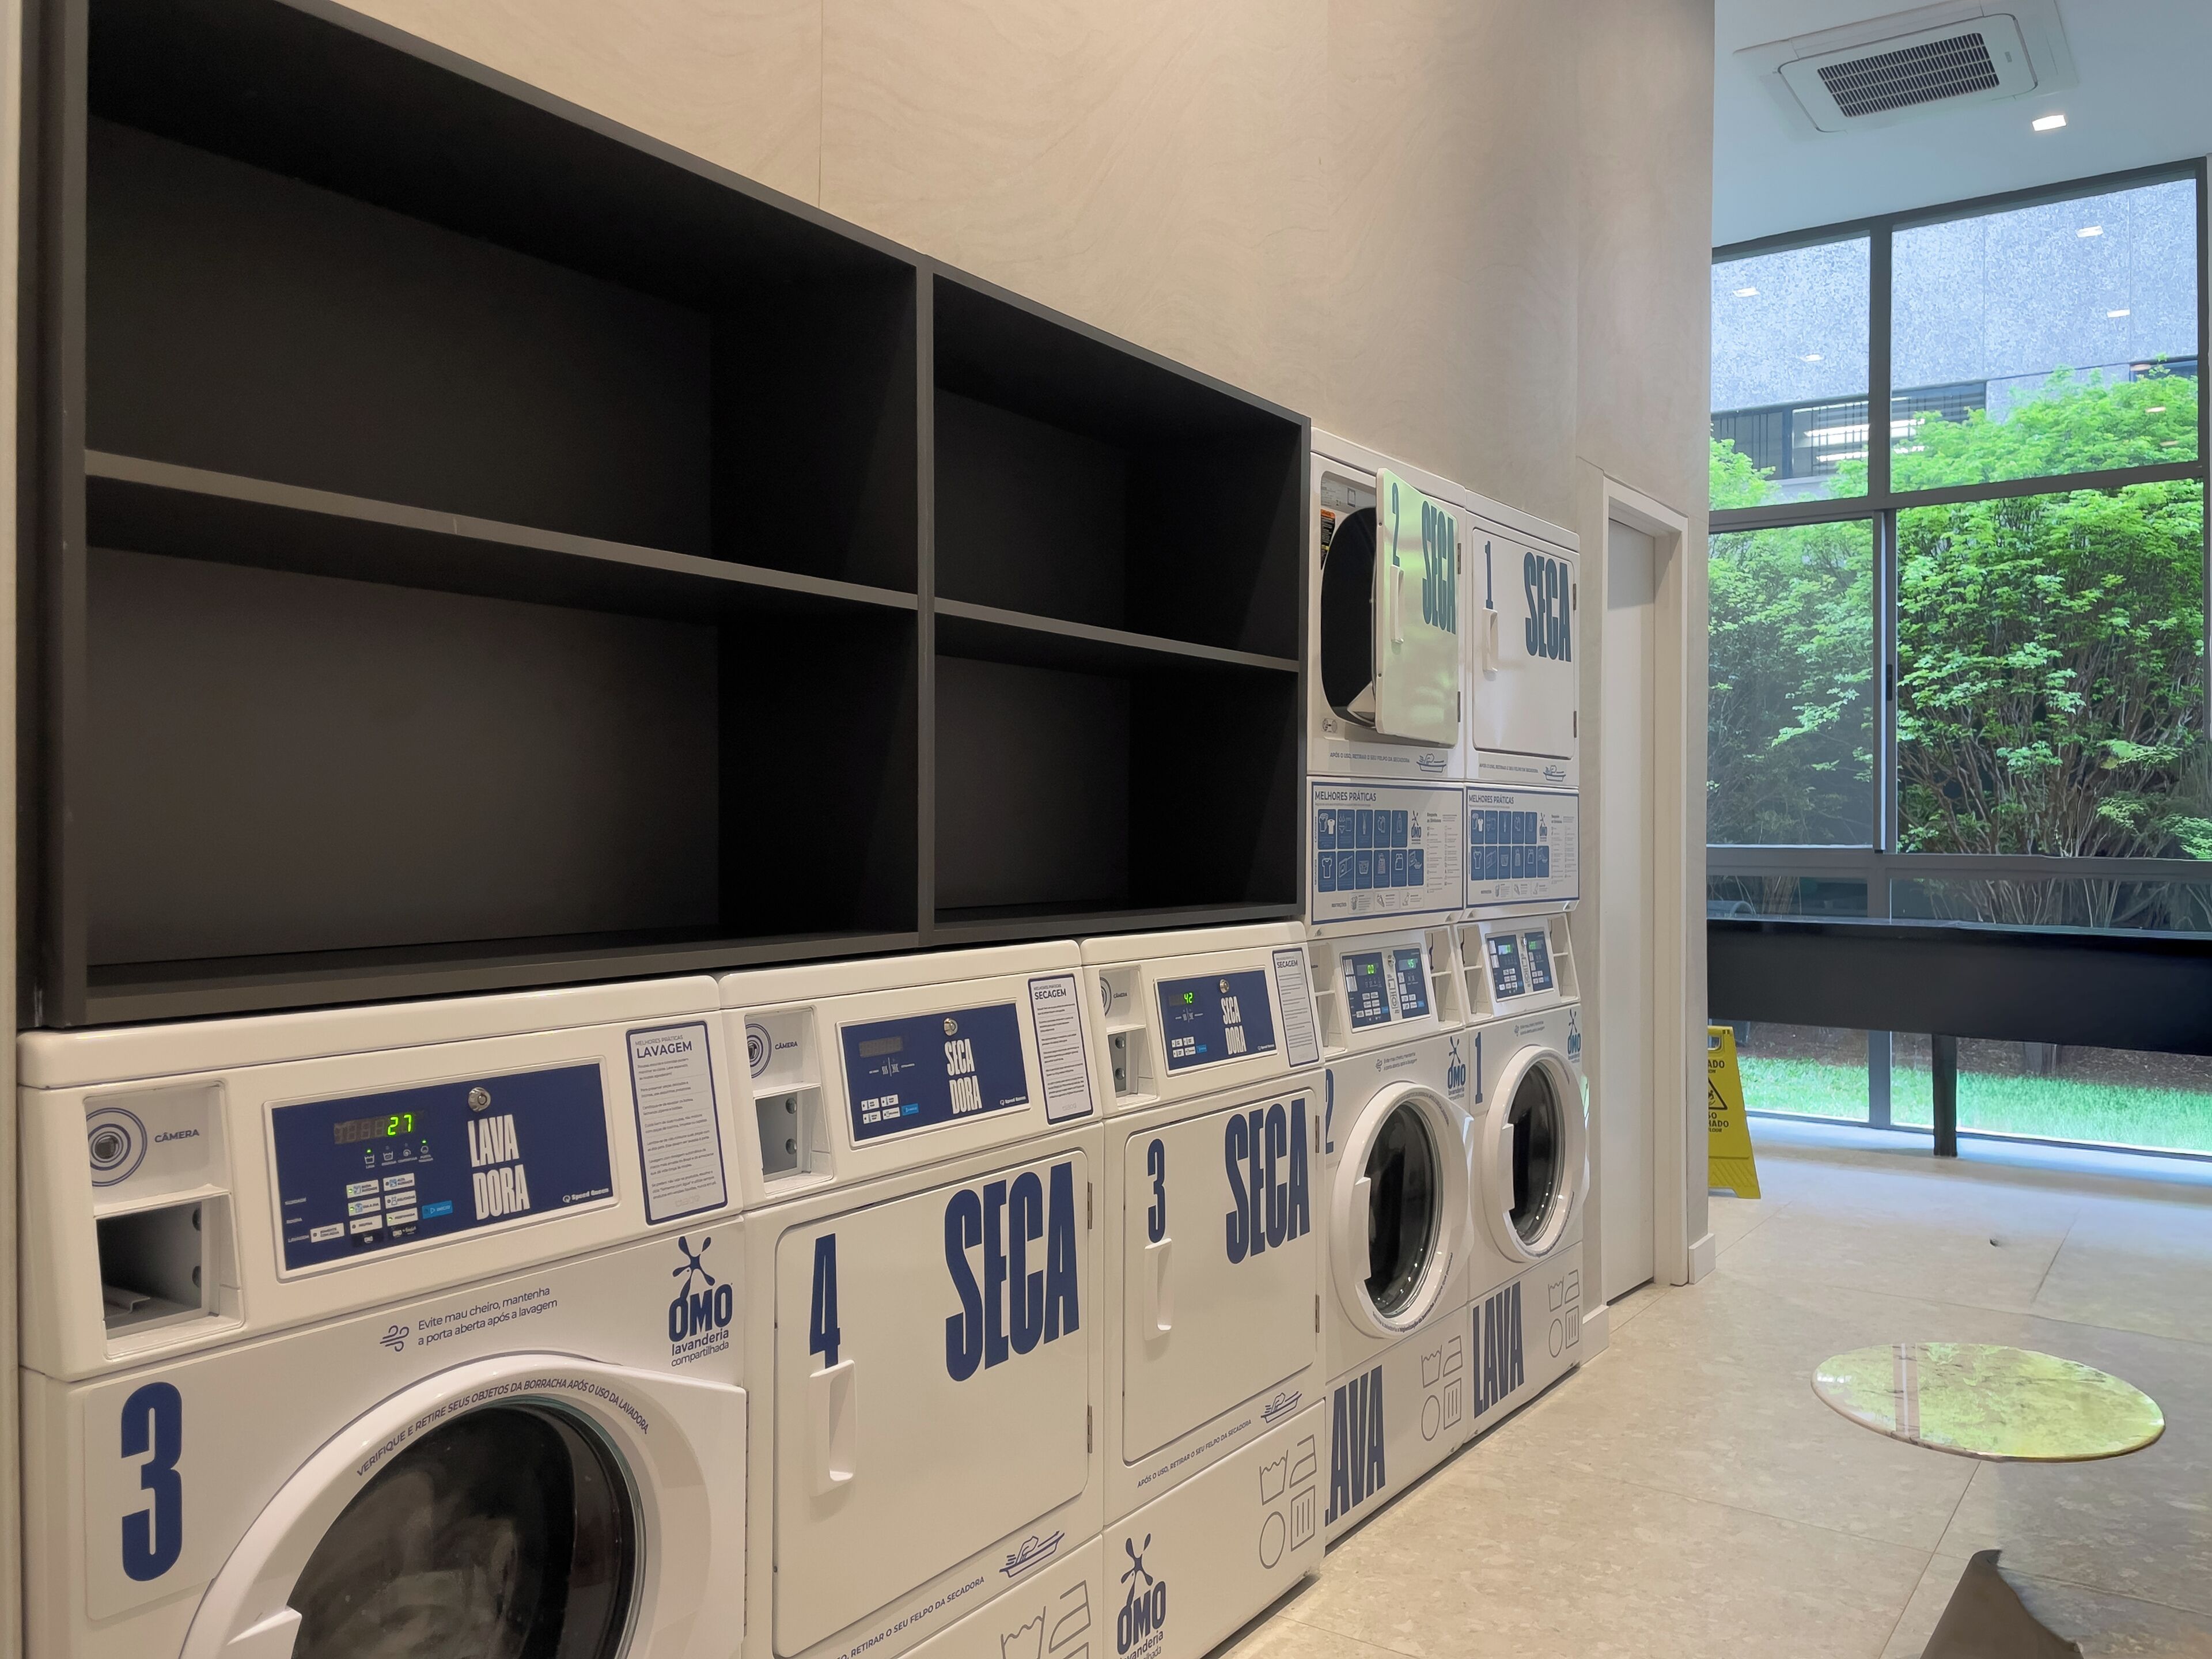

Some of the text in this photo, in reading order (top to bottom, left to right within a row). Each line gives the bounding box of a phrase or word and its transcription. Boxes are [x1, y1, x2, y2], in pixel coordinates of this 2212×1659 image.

[1392, 482, 1400, 567] 2
[1422, 501, 1456, 634] SECA
[1484, 540, 1493, 609] 1
[1524, 552, 1571, 662] SECA
[1315, 791, 1376, 801] MELHORES PRÁTICAS
[1469, 794, 1514, 804] MELHORES PRÁTICAS
[1035, 988, 1066, 1000] SECAGEM
[1184, 993, 1193, 1003] 42
[1221, 996, 1241, 1025] SECA
[635, 1037, 661, 1046] MELHORES
[637, 1041, 692, 1059] LAVAGEM
[775, 1041, 798, 1050] CÂMERA
[945, 1039, 975, 1076] SECA
[1225, 1025, 1247, 1055] DORA
[949, 1075, 983, 1114] DORA
[1448, 1064, 1465, 1089] OMO
[1475, 1032, 1483, 1104] 1
[154, 1128, 199, 1143] CÂMERA
[387, 1114, 412, 1135] 27
[468, 1114, 520, 1168] LAVA
[472, 1164, 531, 1220] DORA
[1147, 1138, 1165, 1243] 3
[1225, 1098, 1310, 1264] SECA
[945, 1161, 1080, 1381] SECA
[418, 1287, 550, 1330] Evite mau cheiro, mantenha
[418, 1300, 558, 1346] a porta aberta após a lavagem
[669, 1284, 733, 1342] OMO
[809, 1233, 840, 1369] 4
[671, 1341, 729, 1367] compartilhada
[672, 1328, 729, 1356] lavanderia
[1474, 1281, 1525, 1419] LAVA
[357, 1378, 649, 1476] VERIFIQUE E RETIRE SEUS OBJETOS DA BORRACHA APÓS O USO DA LAVADORA
[1137, 1475, 1152, 1488] APÓS
[1157, 1466, 1169, 1476] USO,
[1170, 1453, 1190, 1469] RETIRAR
[1195, 1447, 1205, 1456] SEU
[1205, 1437, 1220, 1449] FELPO
[1221, 1433, 1227, 1441] DA
[1228, 1419, 1252, 1437] SECADORA
[1325, 1365, 1385, 1527] AVA
[121, 1382, 182, 1581] 3
[851, 1576, 984, 1658] RETIRAR O SEU FELPO DA SECADORA
[1118, 1581, 1166, 1655] OMO
